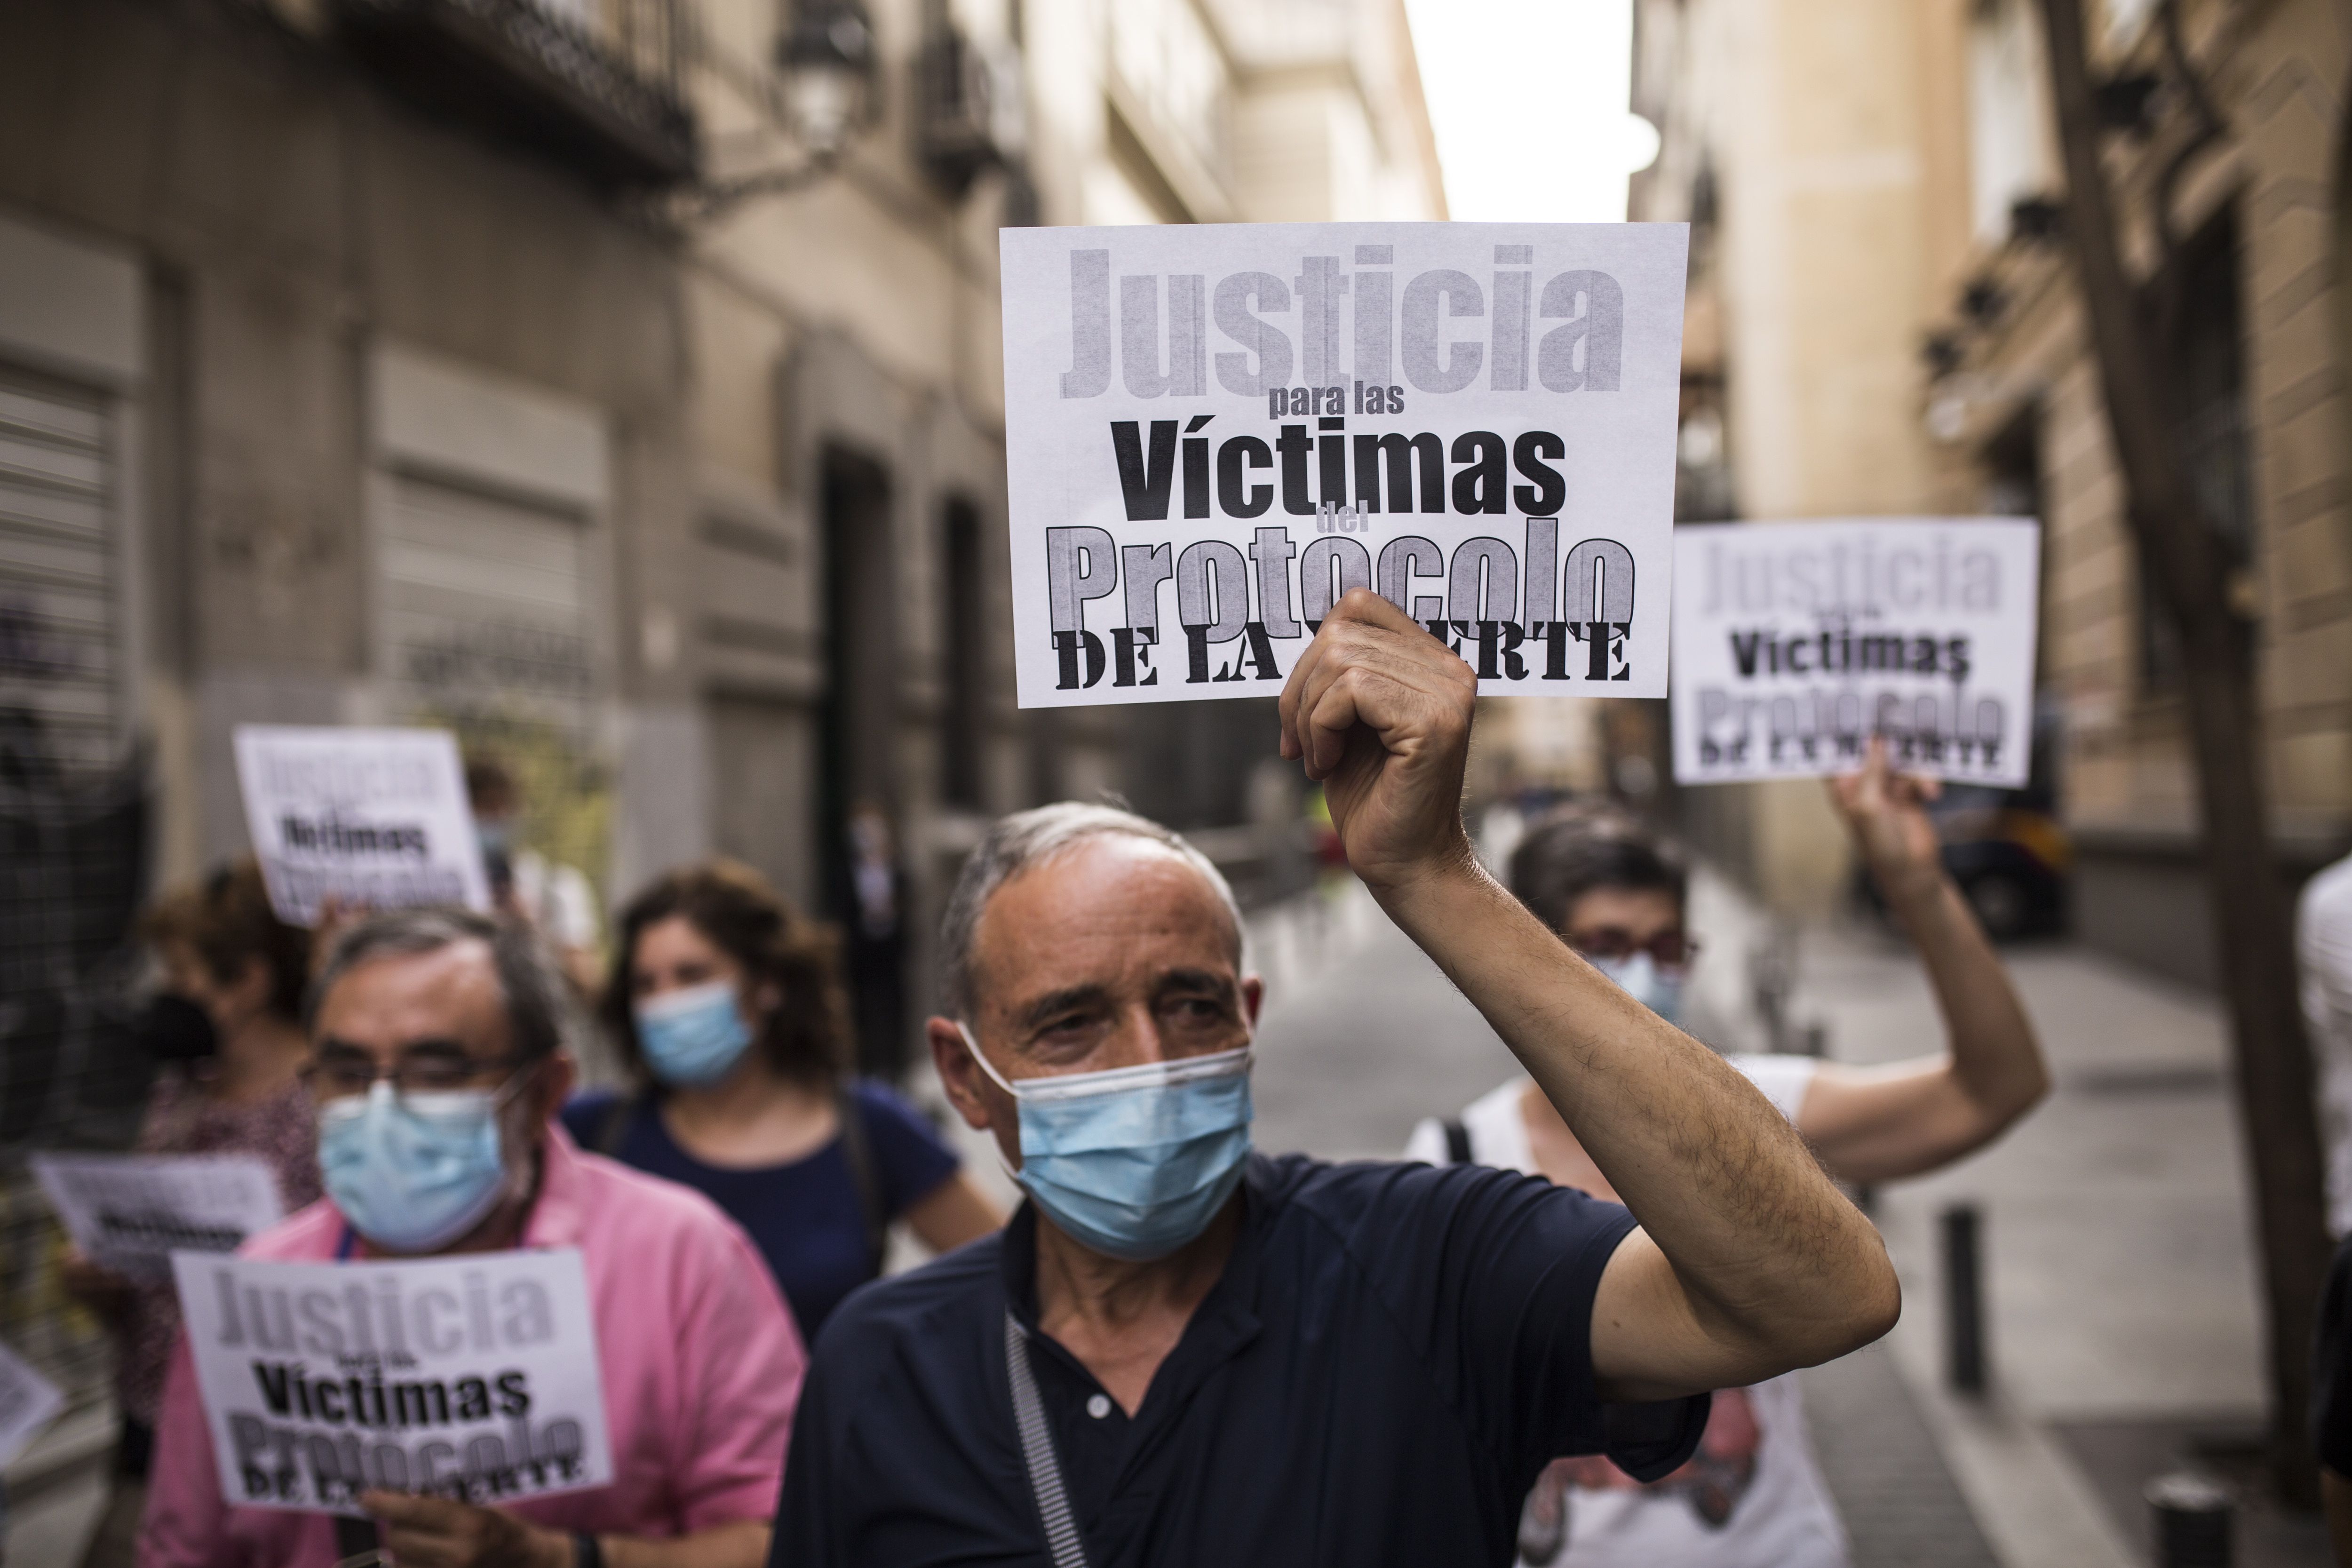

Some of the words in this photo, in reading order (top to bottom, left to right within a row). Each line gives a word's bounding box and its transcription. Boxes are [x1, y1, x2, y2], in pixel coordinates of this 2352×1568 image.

[1059, 245, 1623, 398] Justicia
[1269, 387, 1345, 420] para
[1355, 381, 1405, 414] las
[1111, 415, 1566, 520] Víctimas
[1316, 500, 1368, 533] del
[1047, 517, 1635, 649] Protocolo
[1053, 627, 1158, 690] DE
[1183, 622, 1283, 684] LA
[1305, 620, 1630, 681] ERTE
[214, 1267, 556, 1356] Justicia
[252, 1359, 532, 1429] Víctimas
